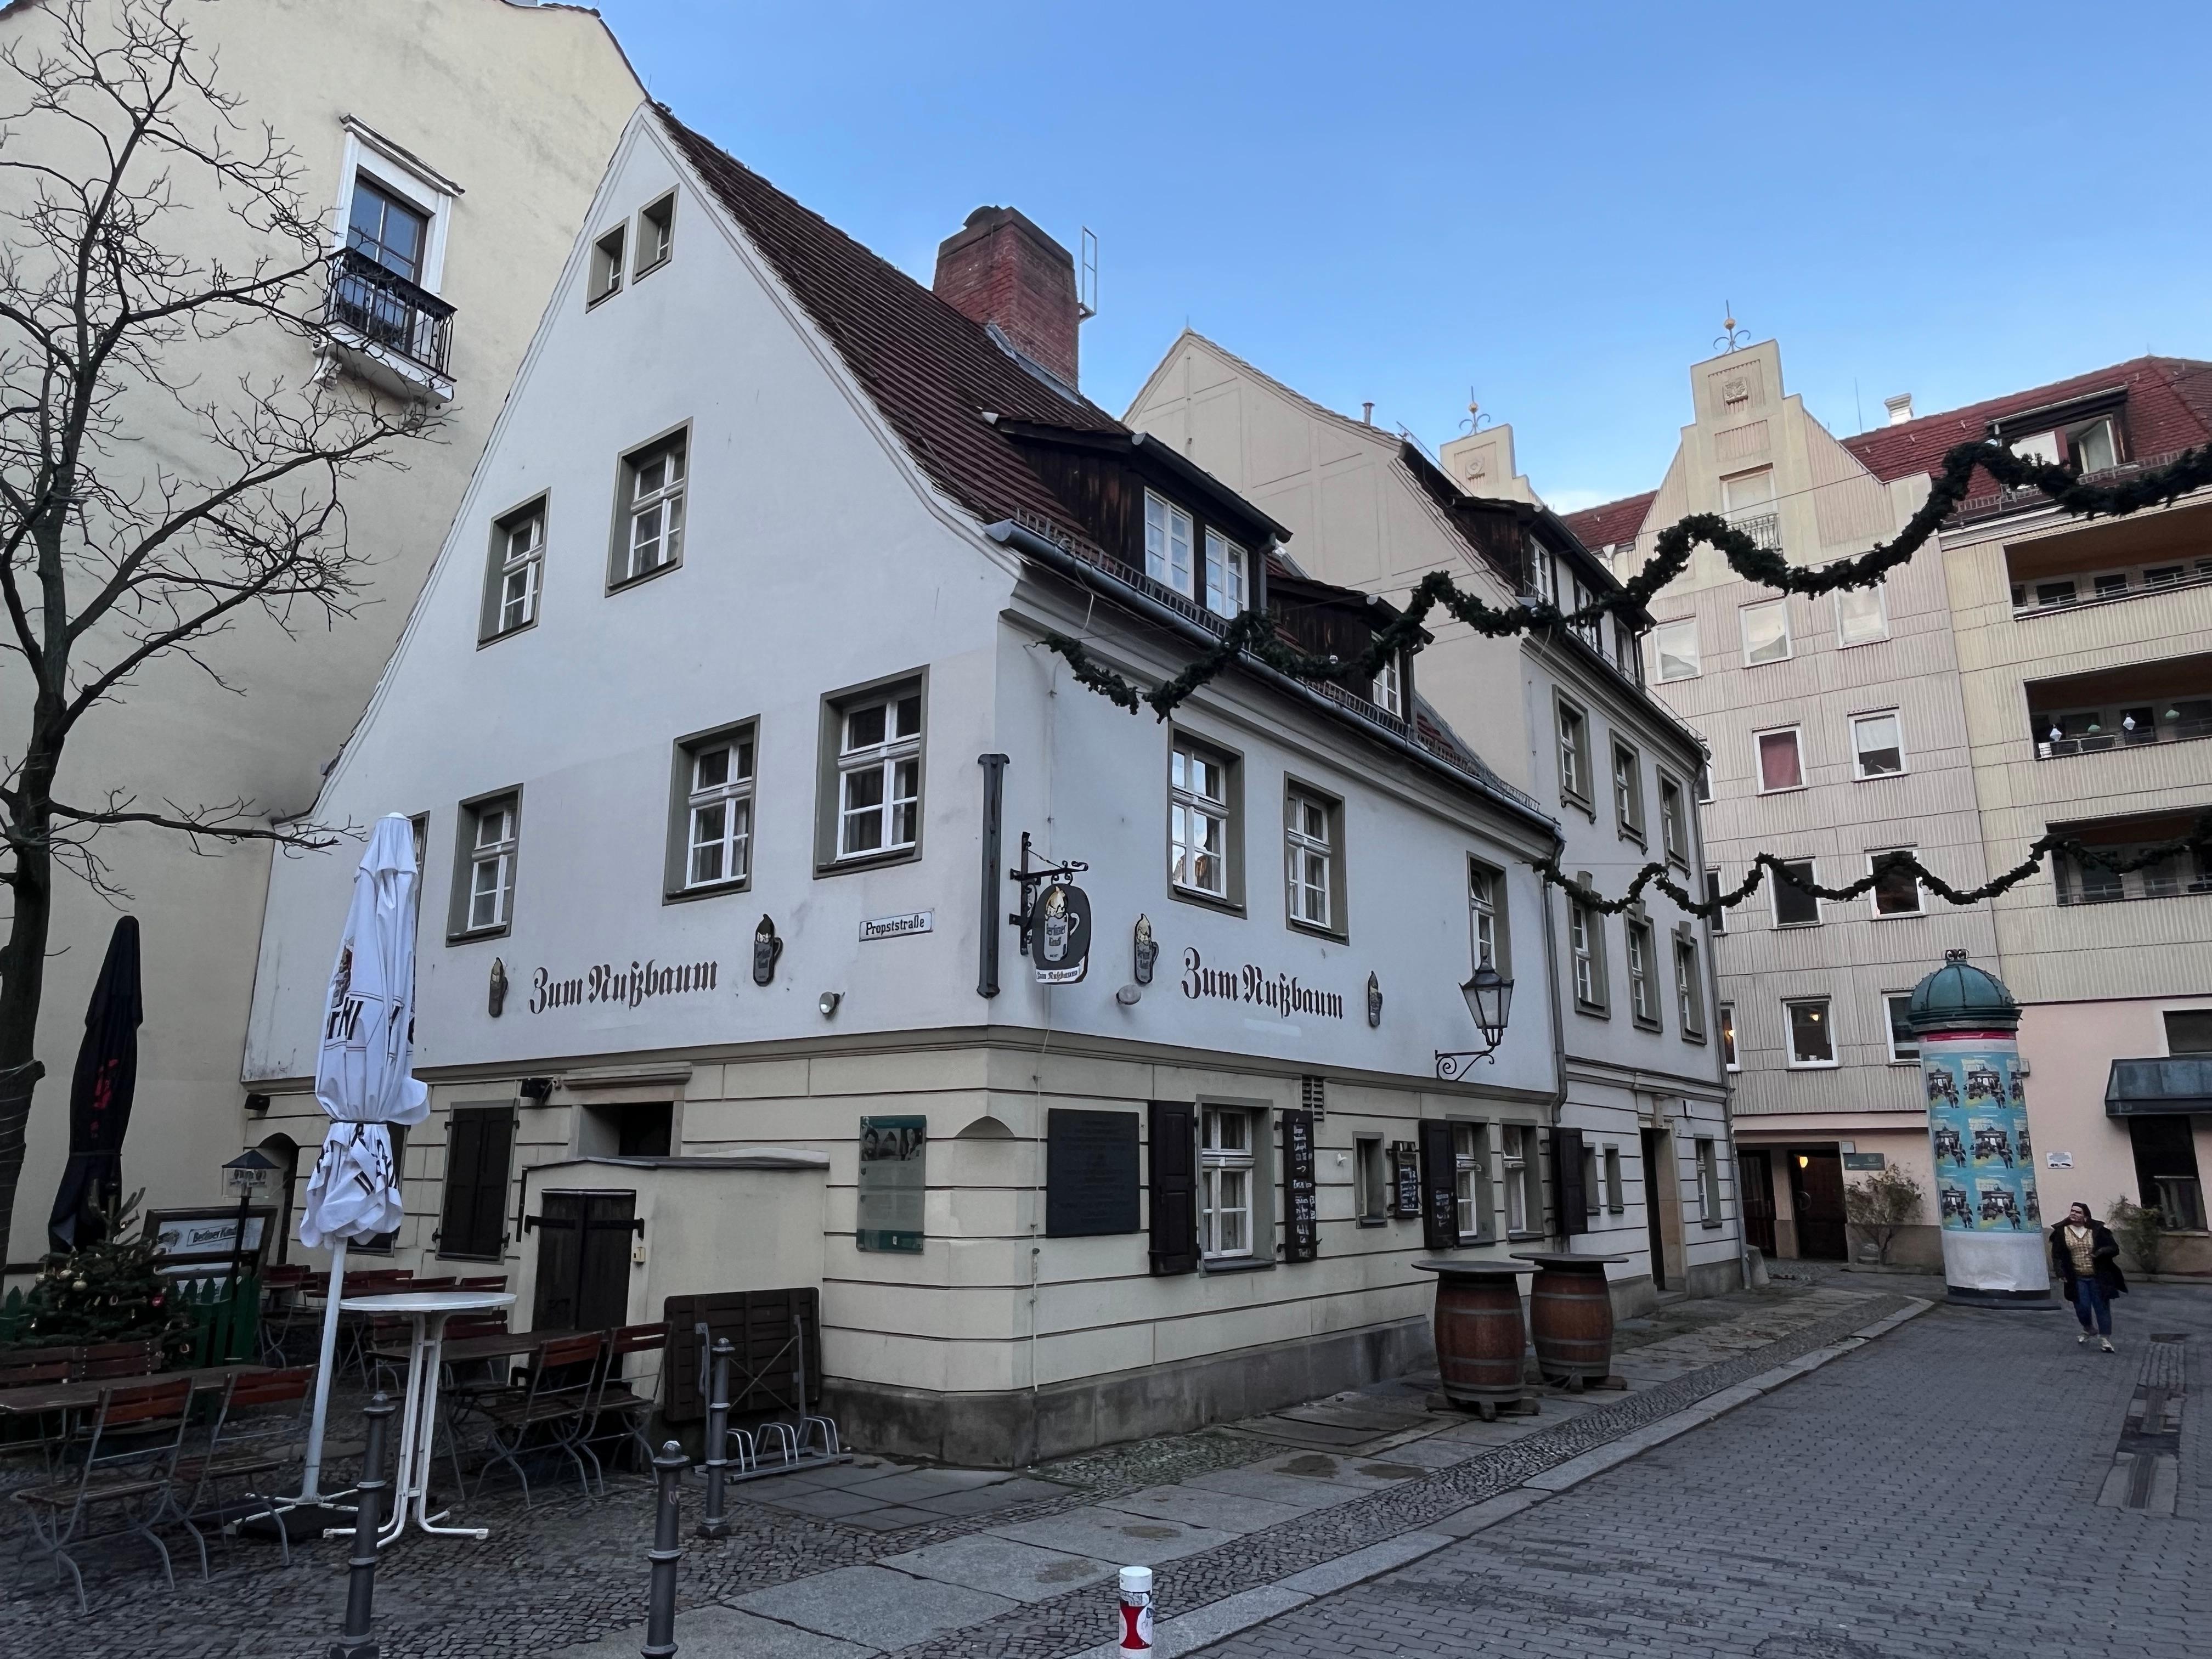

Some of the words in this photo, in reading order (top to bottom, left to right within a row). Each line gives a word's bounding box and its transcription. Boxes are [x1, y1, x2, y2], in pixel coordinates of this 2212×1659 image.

[866, 915, 924, 935] Propststraße
[530, 967, 583, 1014] Zum
[588, 959, 718, 1011] Nußbaum
[1181, 947, 1238, 999] Zum
[1243, 964, 1343, 1019] Nußbaum
